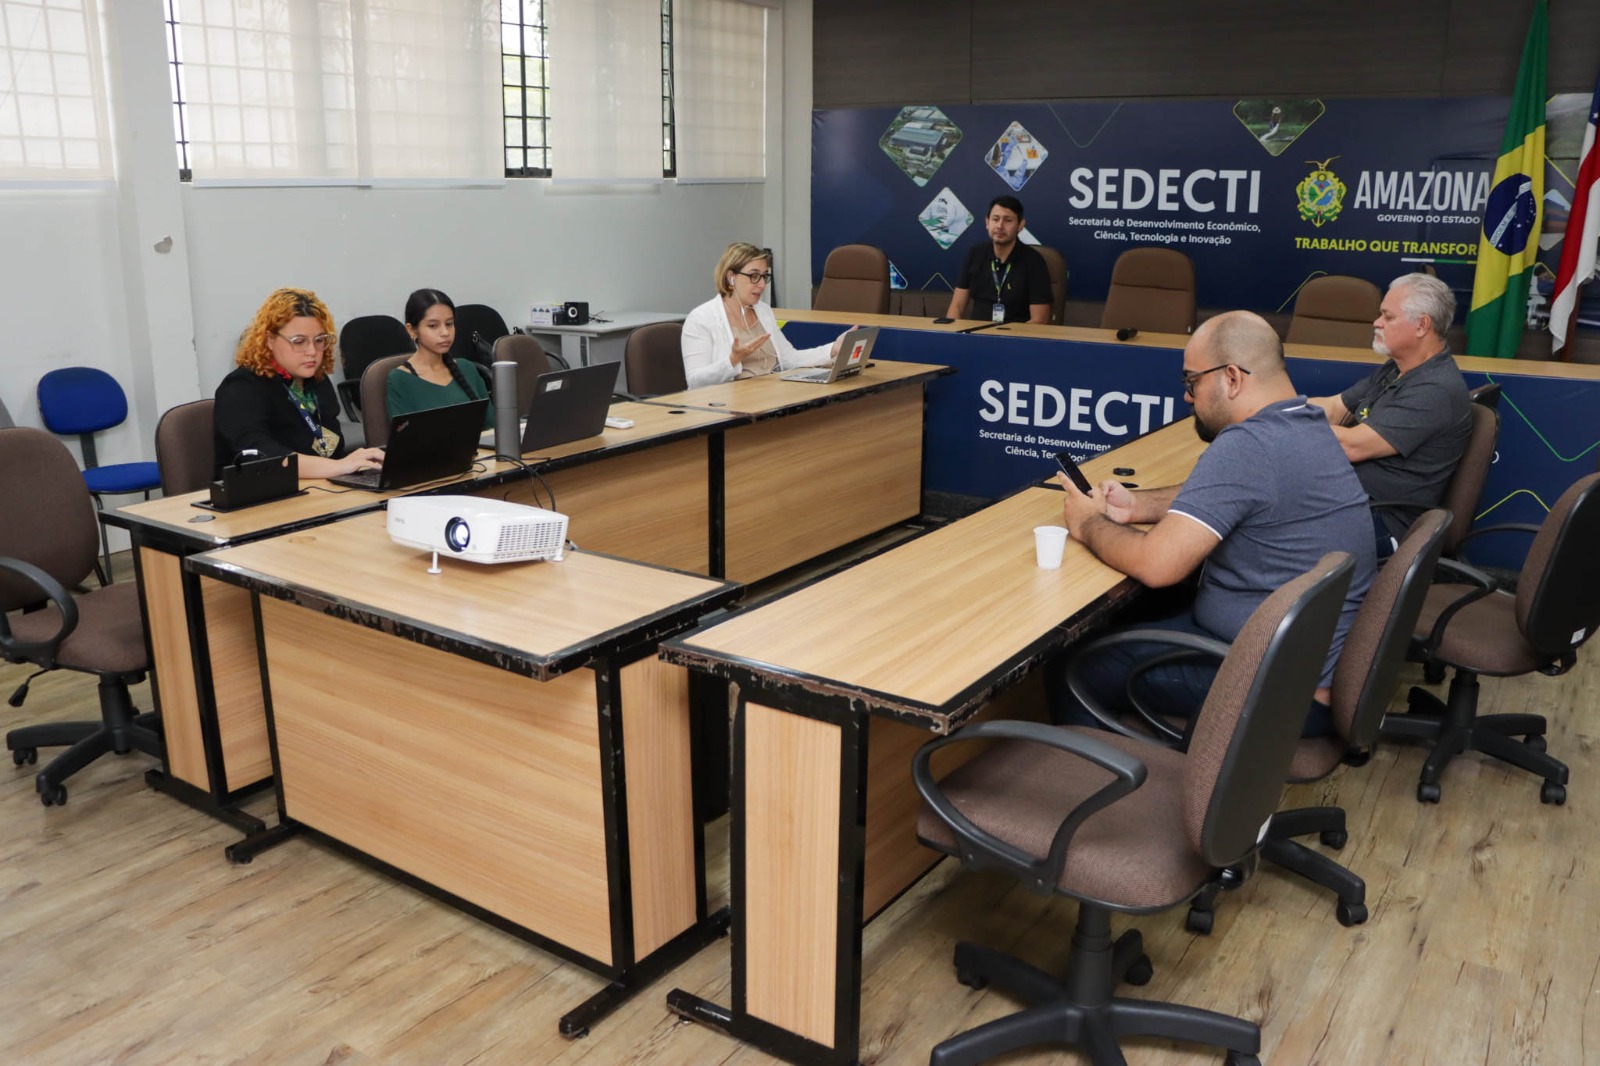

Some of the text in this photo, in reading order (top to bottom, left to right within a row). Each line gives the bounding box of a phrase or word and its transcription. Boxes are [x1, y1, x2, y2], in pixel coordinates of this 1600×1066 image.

[1068, 167, 1261, 213] SEDECTI
[1353, 170, 1490, 211] AMAZONA
[1068, 216, 1261, 233] Secretaria de Desenvolvimento Econômico,
[1377, 214, 1481, 225] GOVERNO DO ESTADO
[1094, 230, 1128, 241] Ciência,
[1129, 231, 1178, 244] Tecnologia
[1188, 234, 1232, 246] Inovação
[1295, 237, 1478, 256] TRABALHO QUE TRANSFOR
[978, 379, 1174, 436] SEDECTI
[978, 429, 1111, 452] Secretaria de Desenvolvimen
[1005, 445, 1039, 459] Ciência,
